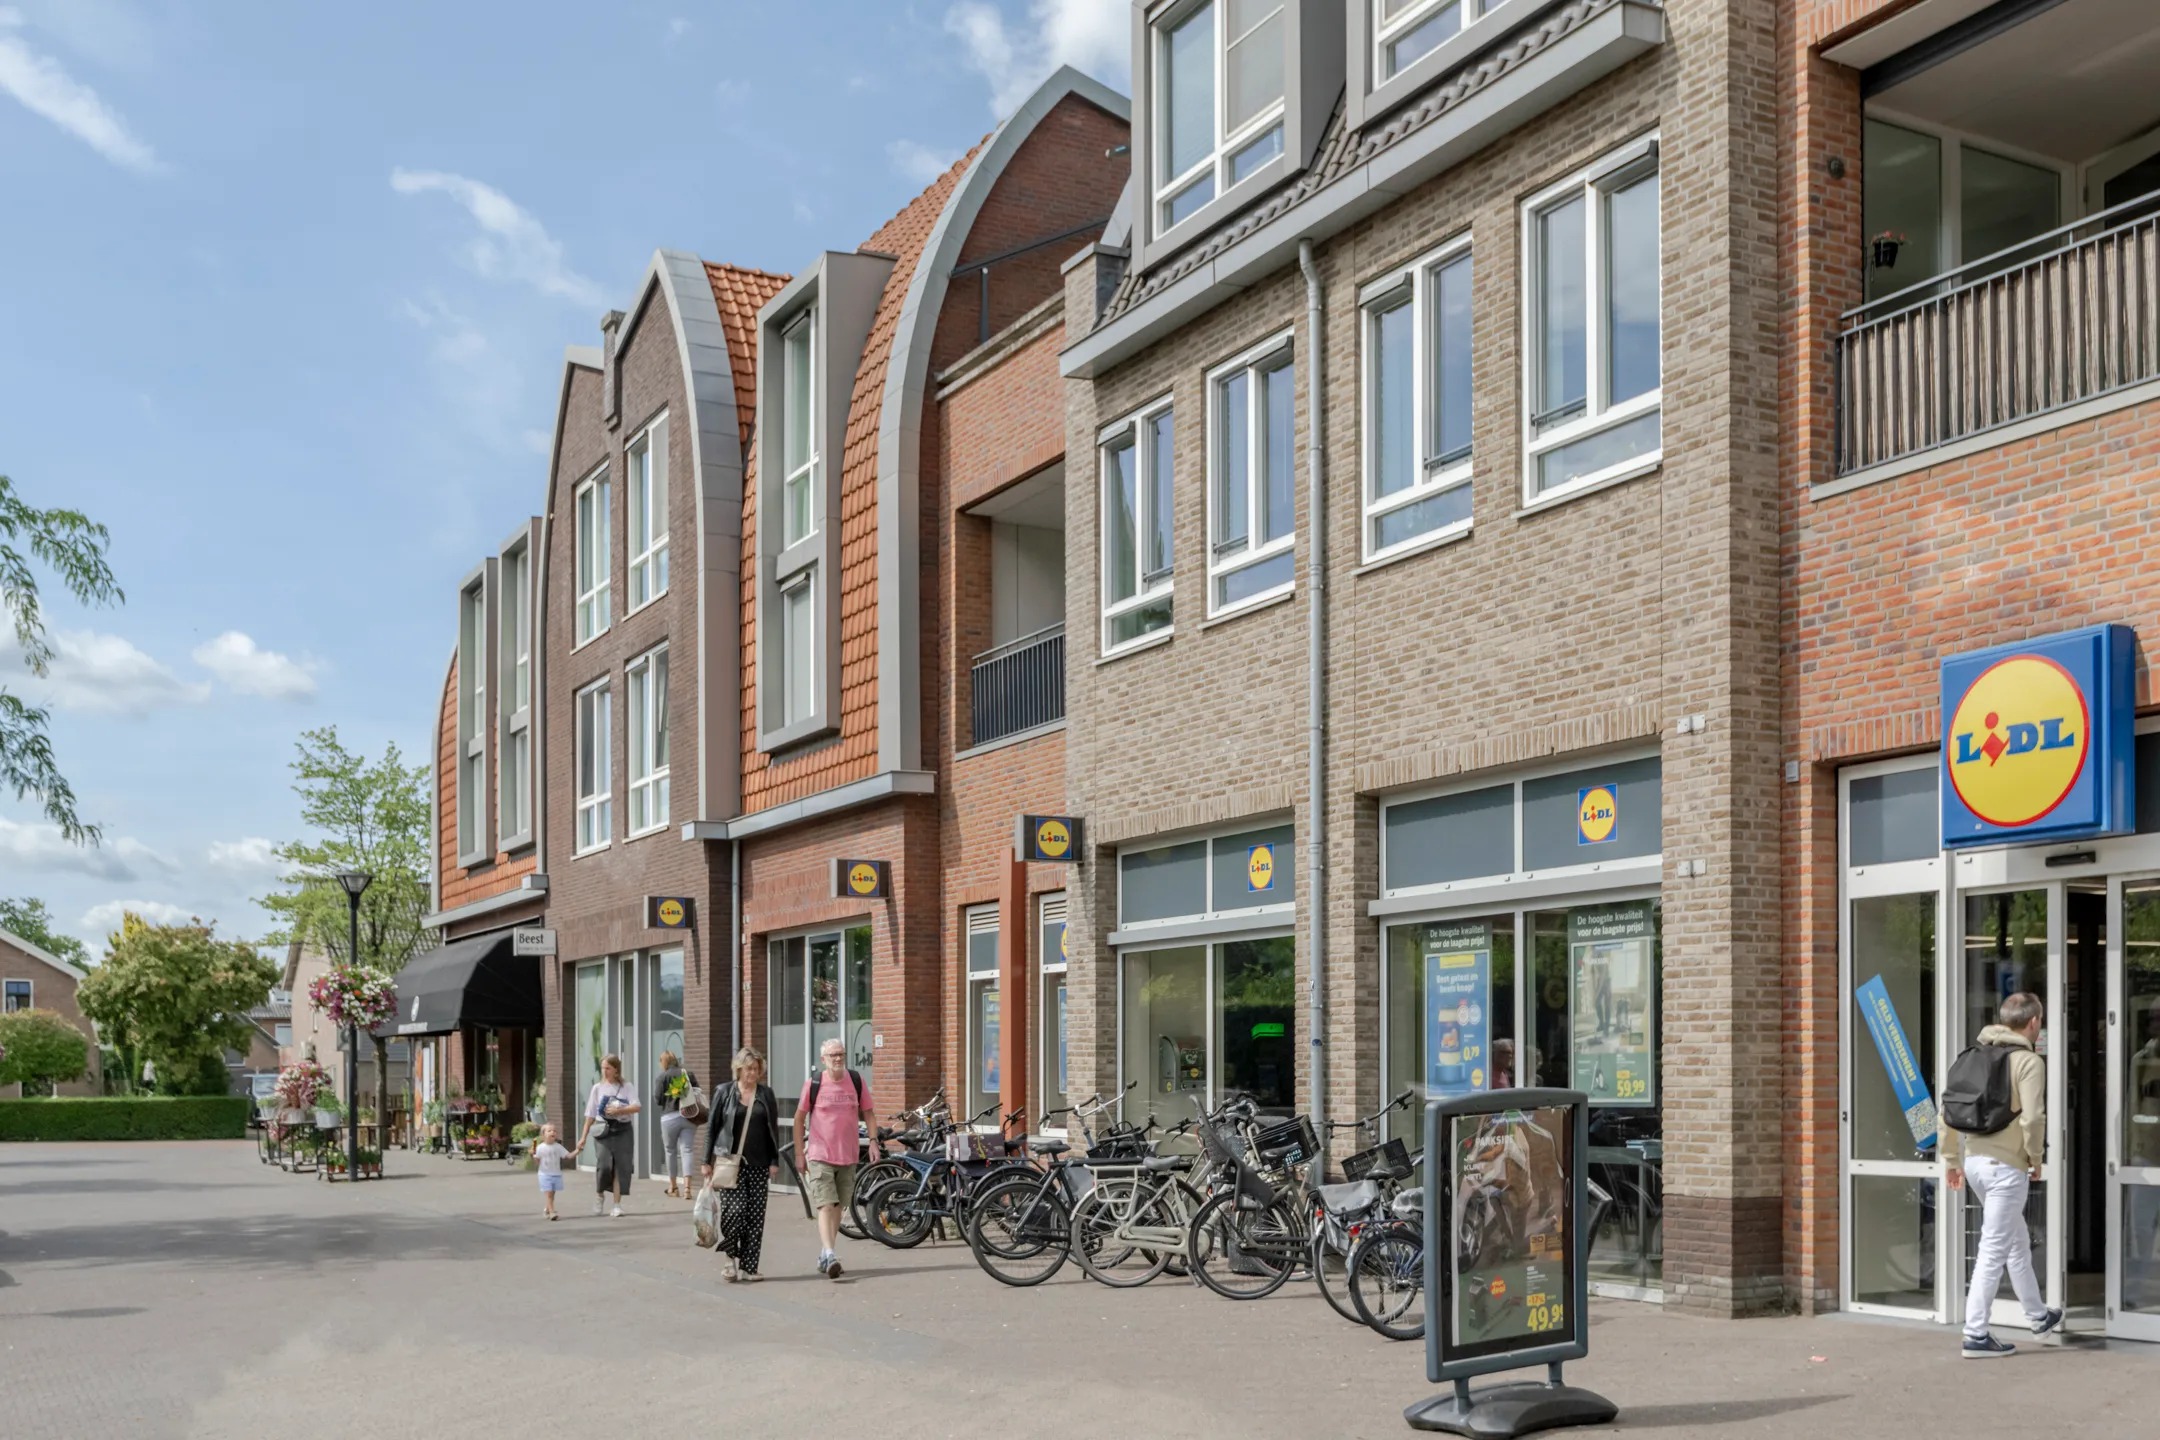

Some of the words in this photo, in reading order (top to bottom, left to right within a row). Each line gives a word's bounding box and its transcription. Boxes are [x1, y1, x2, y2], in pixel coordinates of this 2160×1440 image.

[1577, 916, 1587, 926] De
[1588, 913, 1614, 926] hoogste
[1615, 909, 1644, 921] kwaliteit
[1429, 929, 1438, 938] De
[1438, 927, 1460, 938] hoogste
[1460, 924, 1485, 935] kwaliteit
[1577, 928, 1592, 937] voor
[1593, 926, 1602, 936] de
[1602, 924, 1626, 936] laagste
[1626, 921, 1644, 935] prijs!
[519, 933, 545, 944] Beest
[1450, 937, 1470, 948] laagste
[1878, 998, 1892, 1022] GELD
[1616, 1079, 1646, 1098] 59.99
